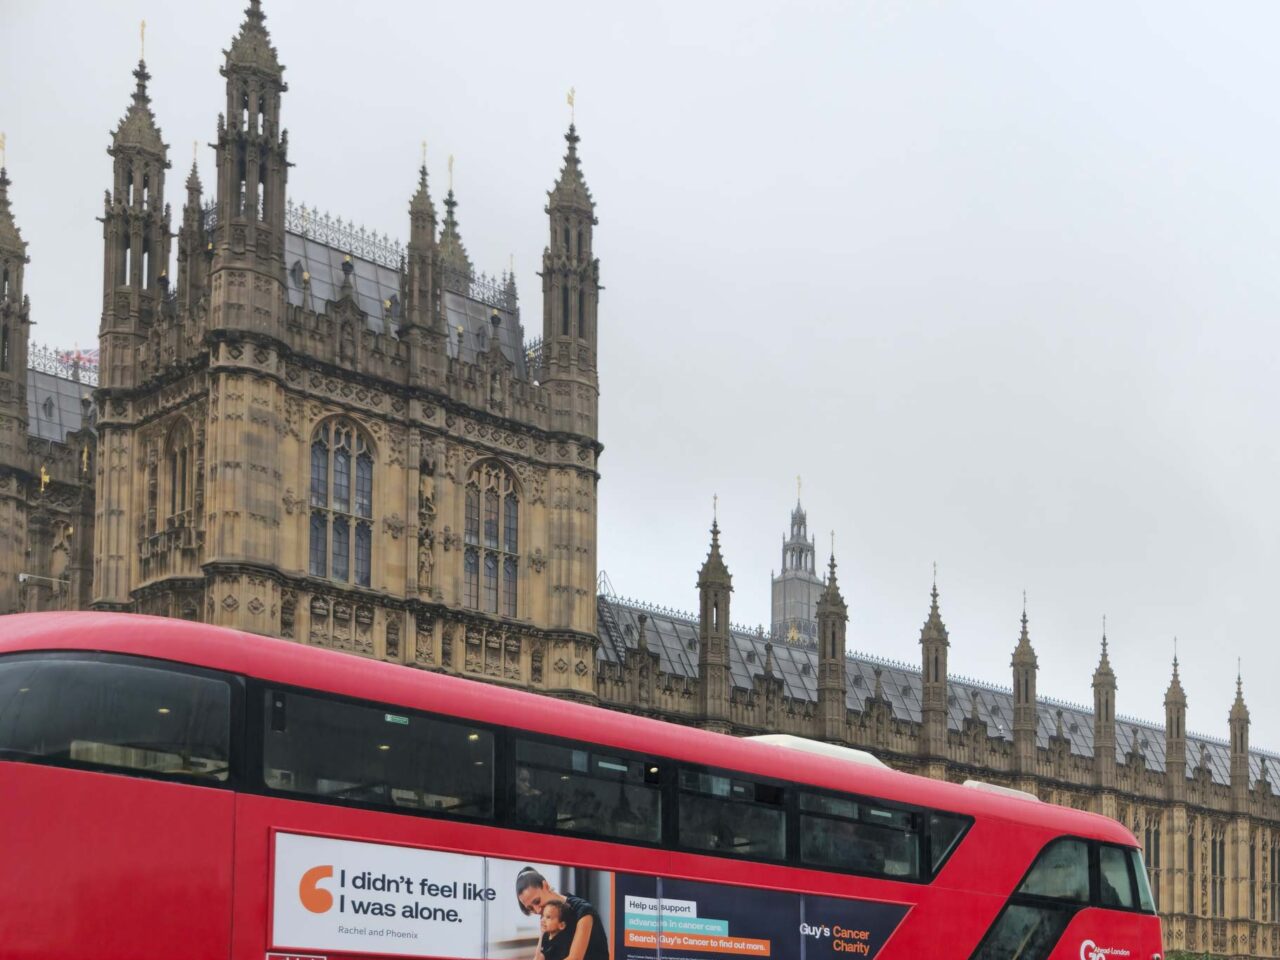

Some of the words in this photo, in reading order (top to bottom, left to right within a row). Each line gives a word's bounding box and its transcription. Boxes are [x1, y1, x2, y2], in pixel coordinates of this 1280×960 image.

[340, 869, 345, 888] I
[351, 871, 414, 894] didn't
[419, 878, 457, 899] feel
[463, 882, 497, 901] like
[339, 895, 345, 913] I
[351, 900, 396, 917] was
[402, 902, 463, 923] alone.
[629, 900, 647, 911] Help
[661, 905, 691, 914] support
[338, 926, 367, 936] Rachel
[368, 928, 384, 937] and
[386, 930, 419, 939] Phoenix
[670, 919, 677, 927] in
[678, 922, 704, 931] cancer
[800, 923, 830, 939] Guy's
[833, 925, 870, 940] Cancer
[629, 933, 657, 943] Search
[660, 935, 681, 945] Guy's
[683, 937, 709, 947] Cancer
[710, 939, 718, 947] to
[719, 940, 733, 948] find
[833, 939, 870, 956] Charity
